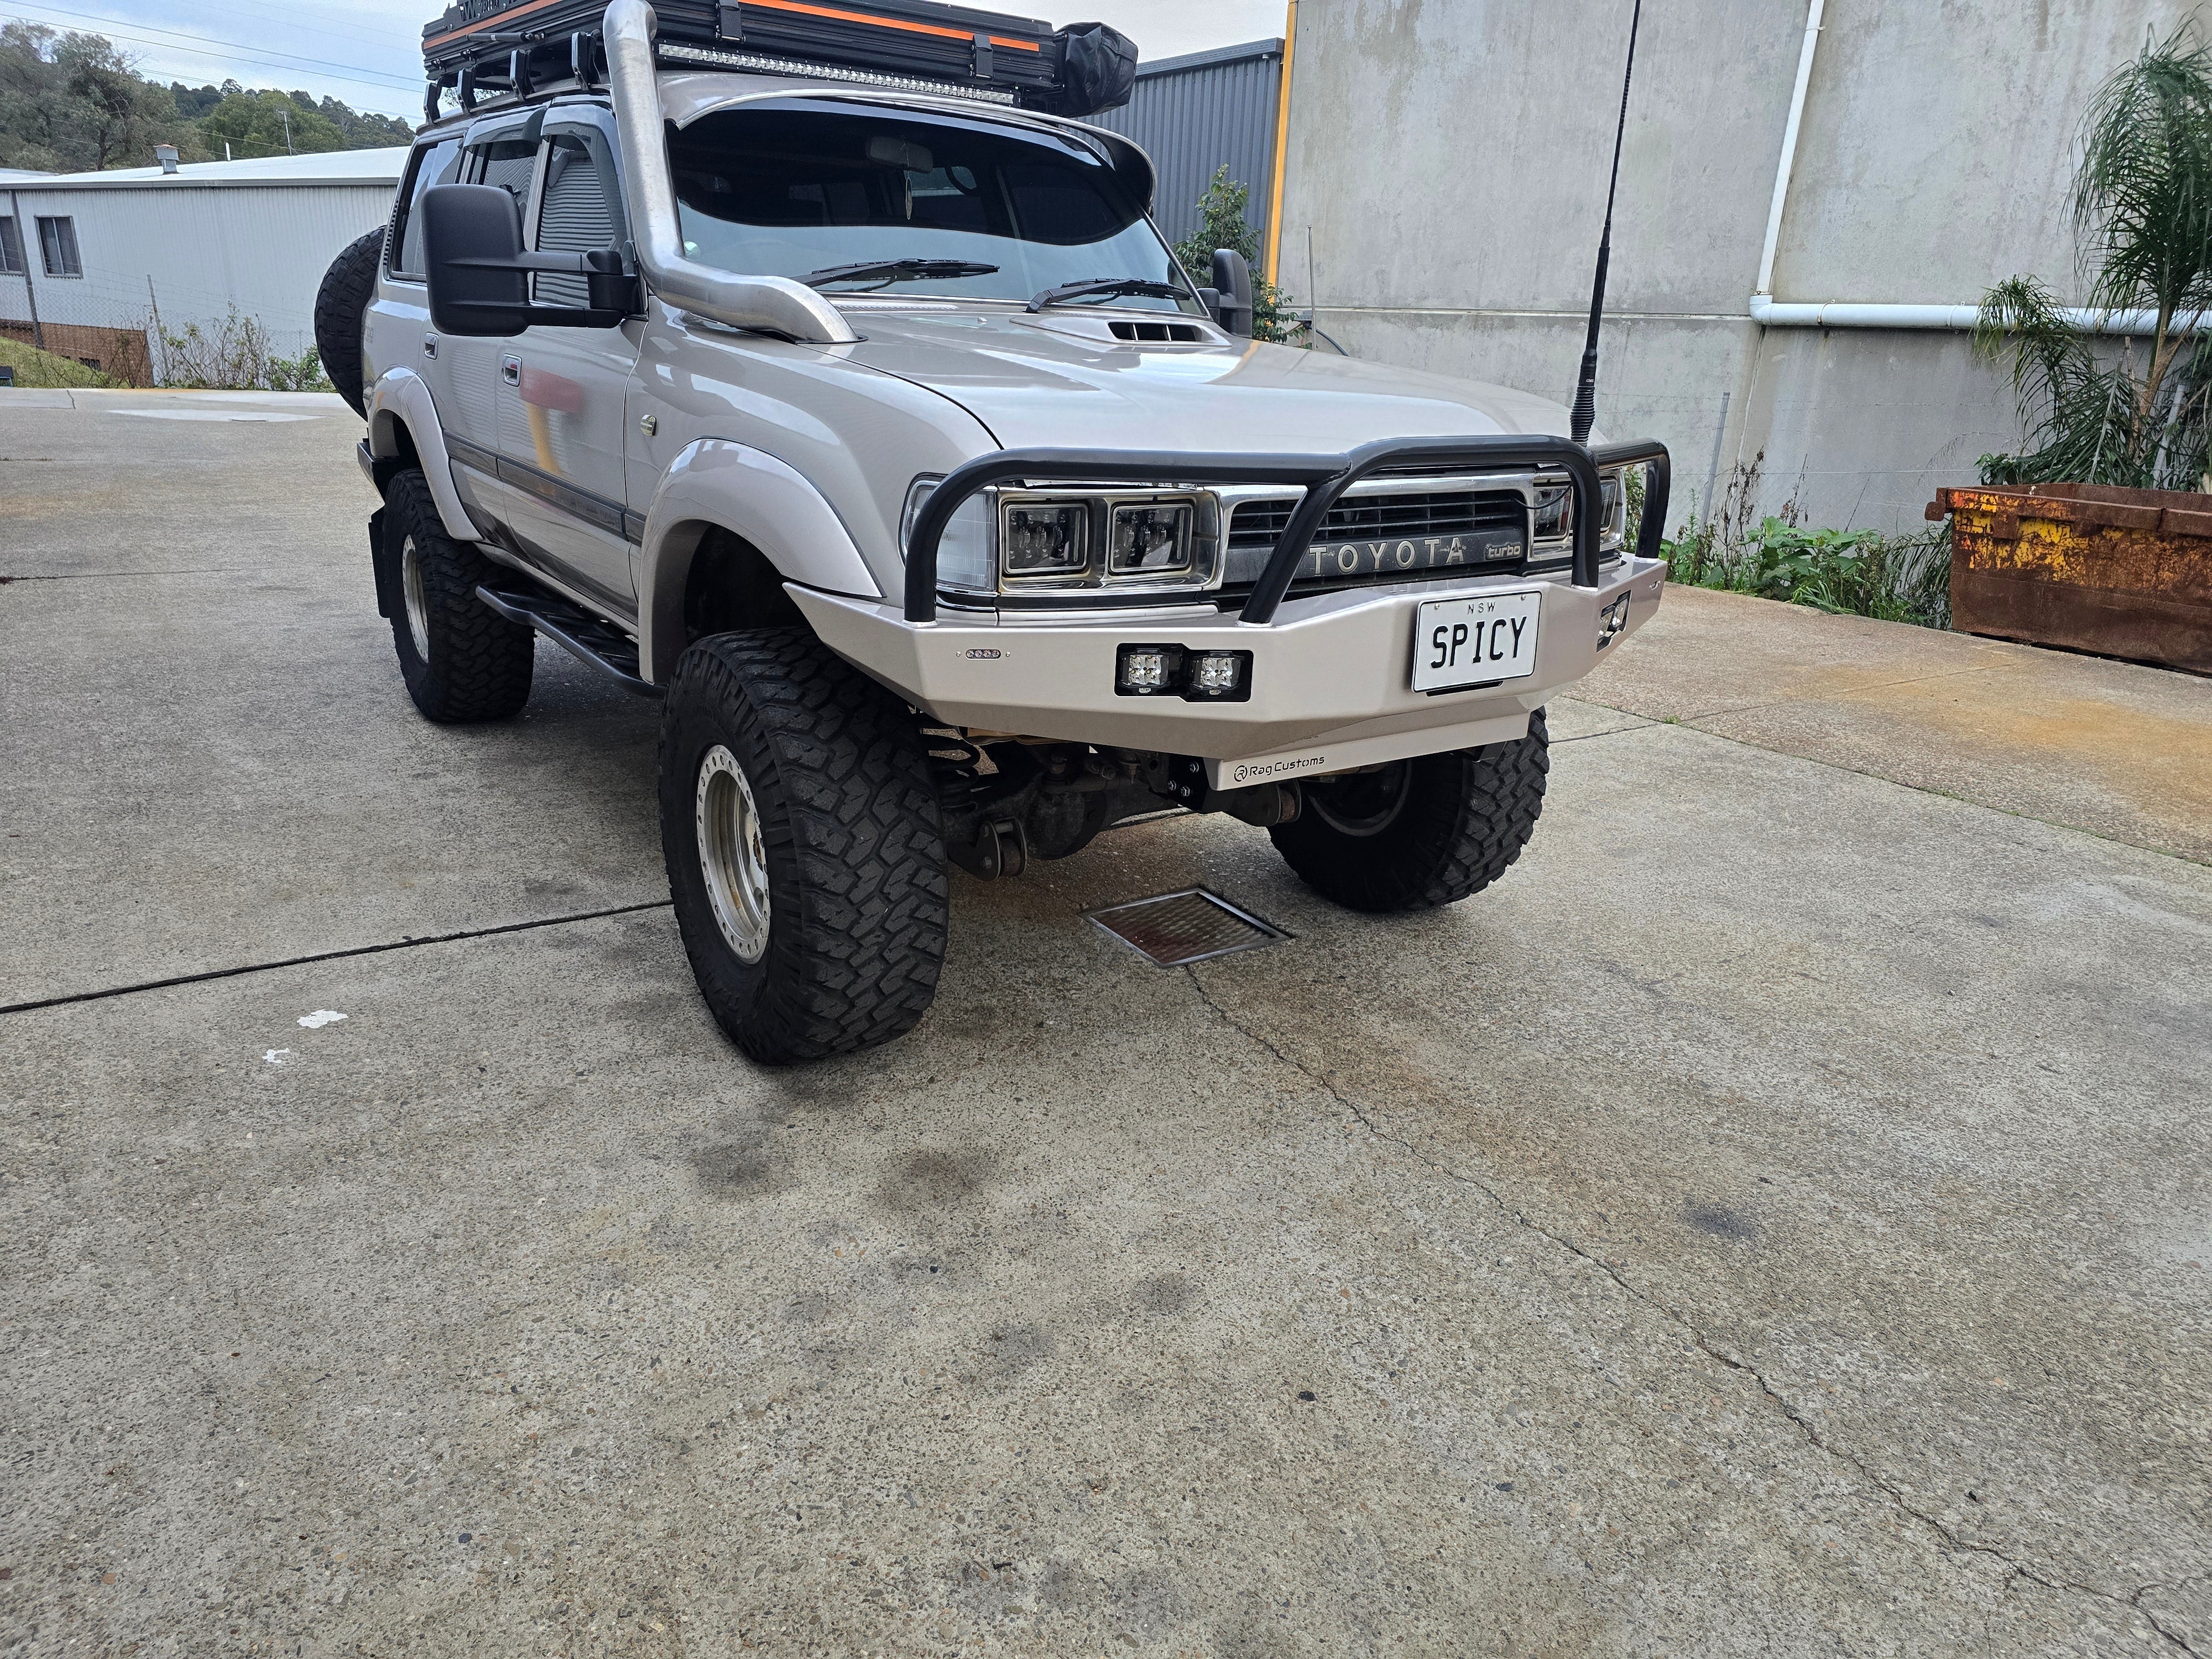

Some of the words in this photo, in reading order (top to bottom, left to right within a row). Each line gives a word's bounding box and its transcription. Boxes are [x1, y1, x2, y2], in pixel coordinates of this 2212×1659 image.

[1308, 537, 1465, 577] TOYOTA
[1488, 543, 1521, 558] turbo
[1467, 602, 1495, 614] NSW
[1430, 616, 1527, 669] SPICY
[1249, 766, 1272, 776] Rag
[1274, 757, 1324, 772] Customs
